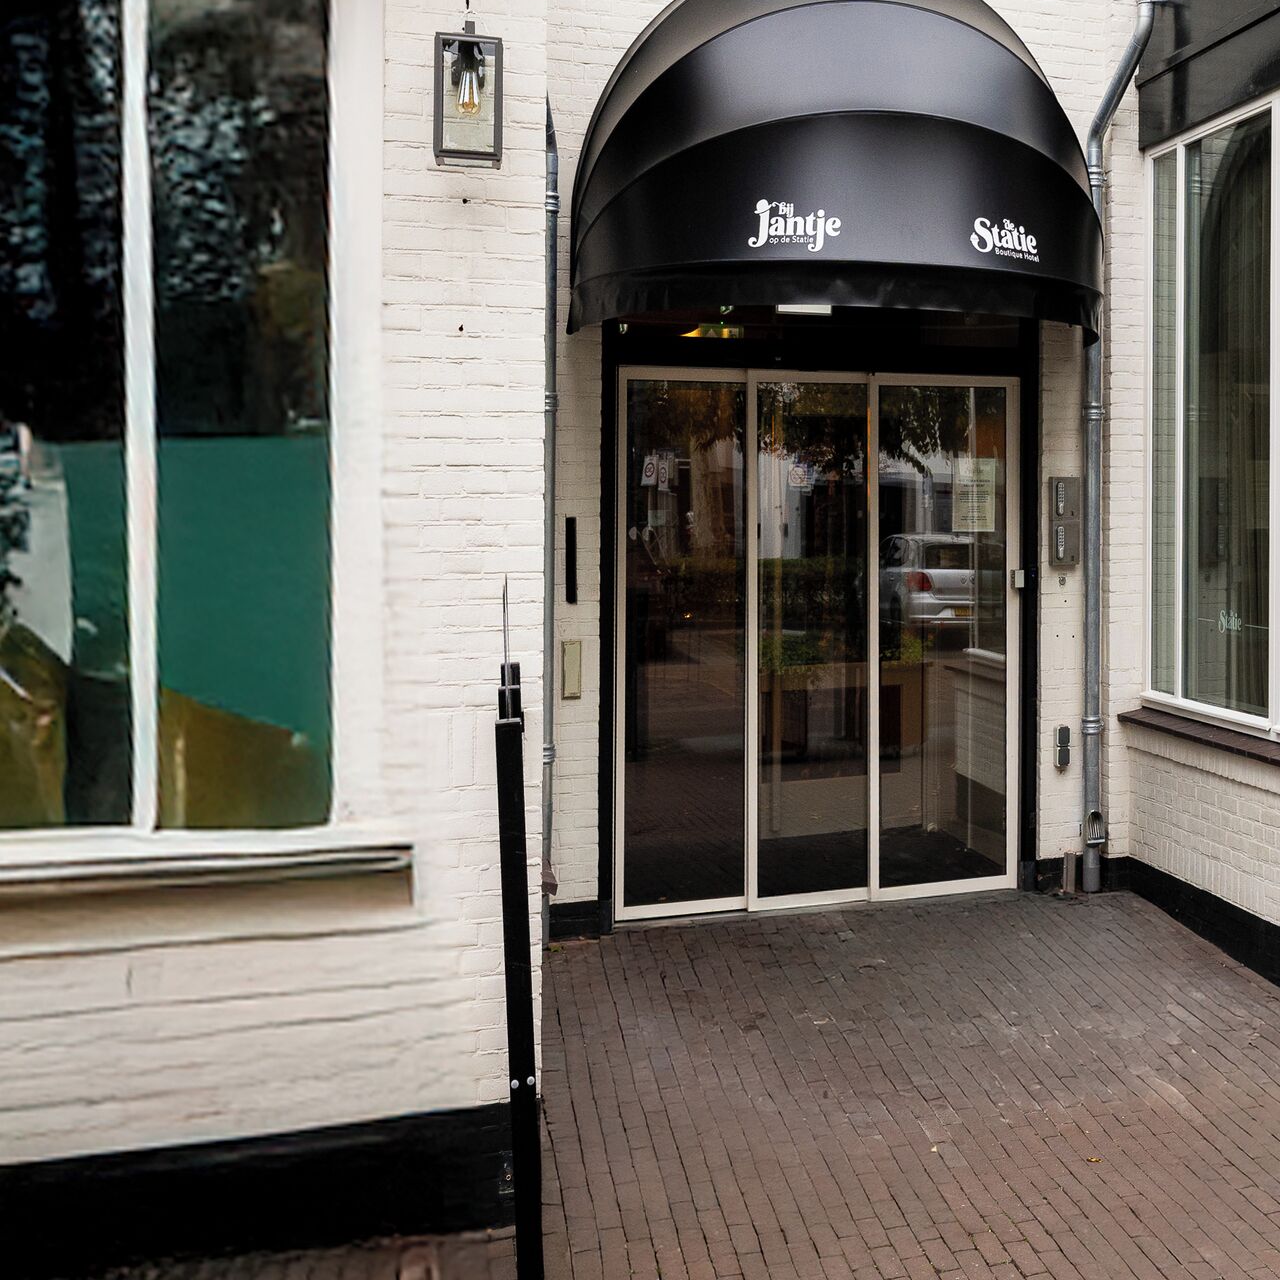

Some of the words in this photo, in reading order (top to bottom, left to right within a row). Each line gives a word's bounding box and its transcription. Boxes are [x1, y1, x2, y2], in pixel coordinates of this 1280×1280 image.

[771, 201, 794, 218] bij
[748, 208, 842, 252] Jantje
[1003, 219, 1015, 231] de
[769, 236, 779, 245] op
[780, 235, 791, 244] de
[791, 235, 814, 244] Statie
[970, 217, 1038, 254] Statie
[995, 247, 1023, 260] Boutique
[1024, 252, 1040, 263] Hotel
